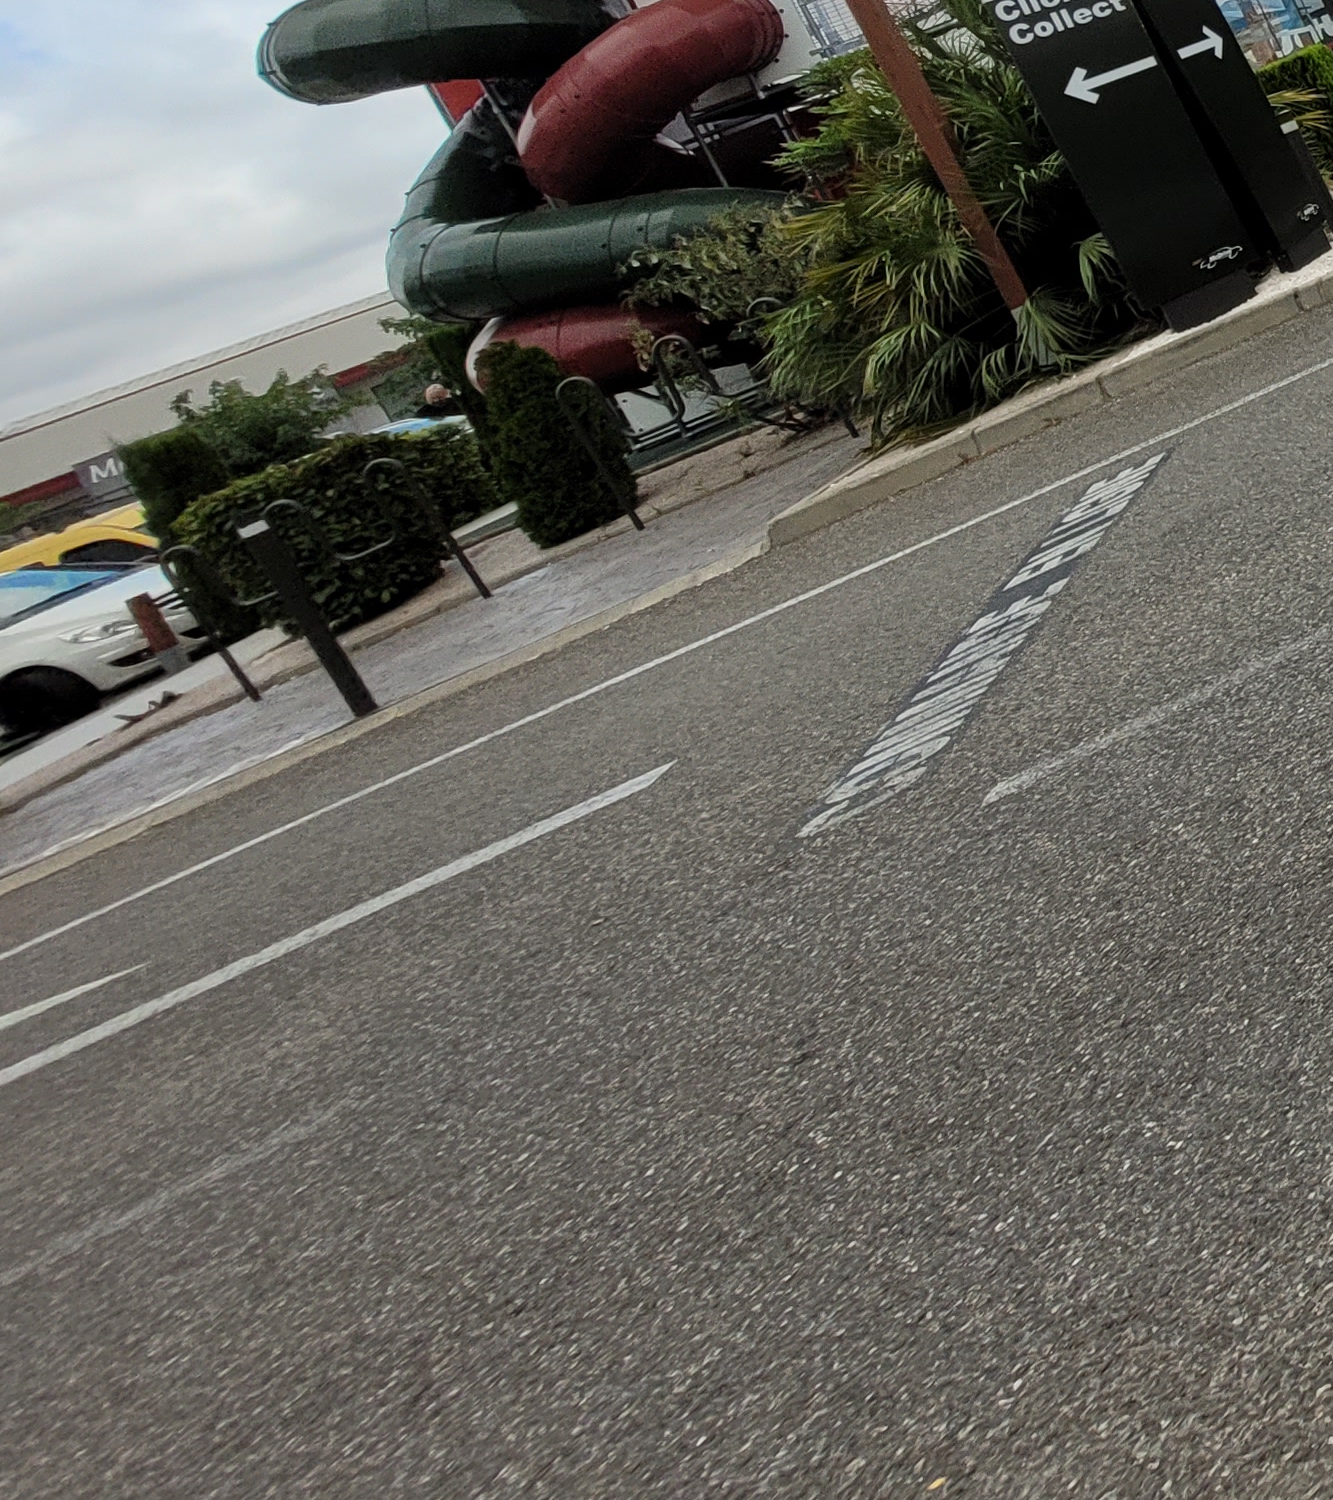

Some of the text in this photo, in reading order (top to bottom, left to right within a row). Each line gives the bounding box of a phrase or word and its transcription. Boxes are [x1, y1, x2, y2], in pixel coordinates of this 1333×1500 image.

[795, 452, 1166, 838] COMMANDE EN LIGNE
